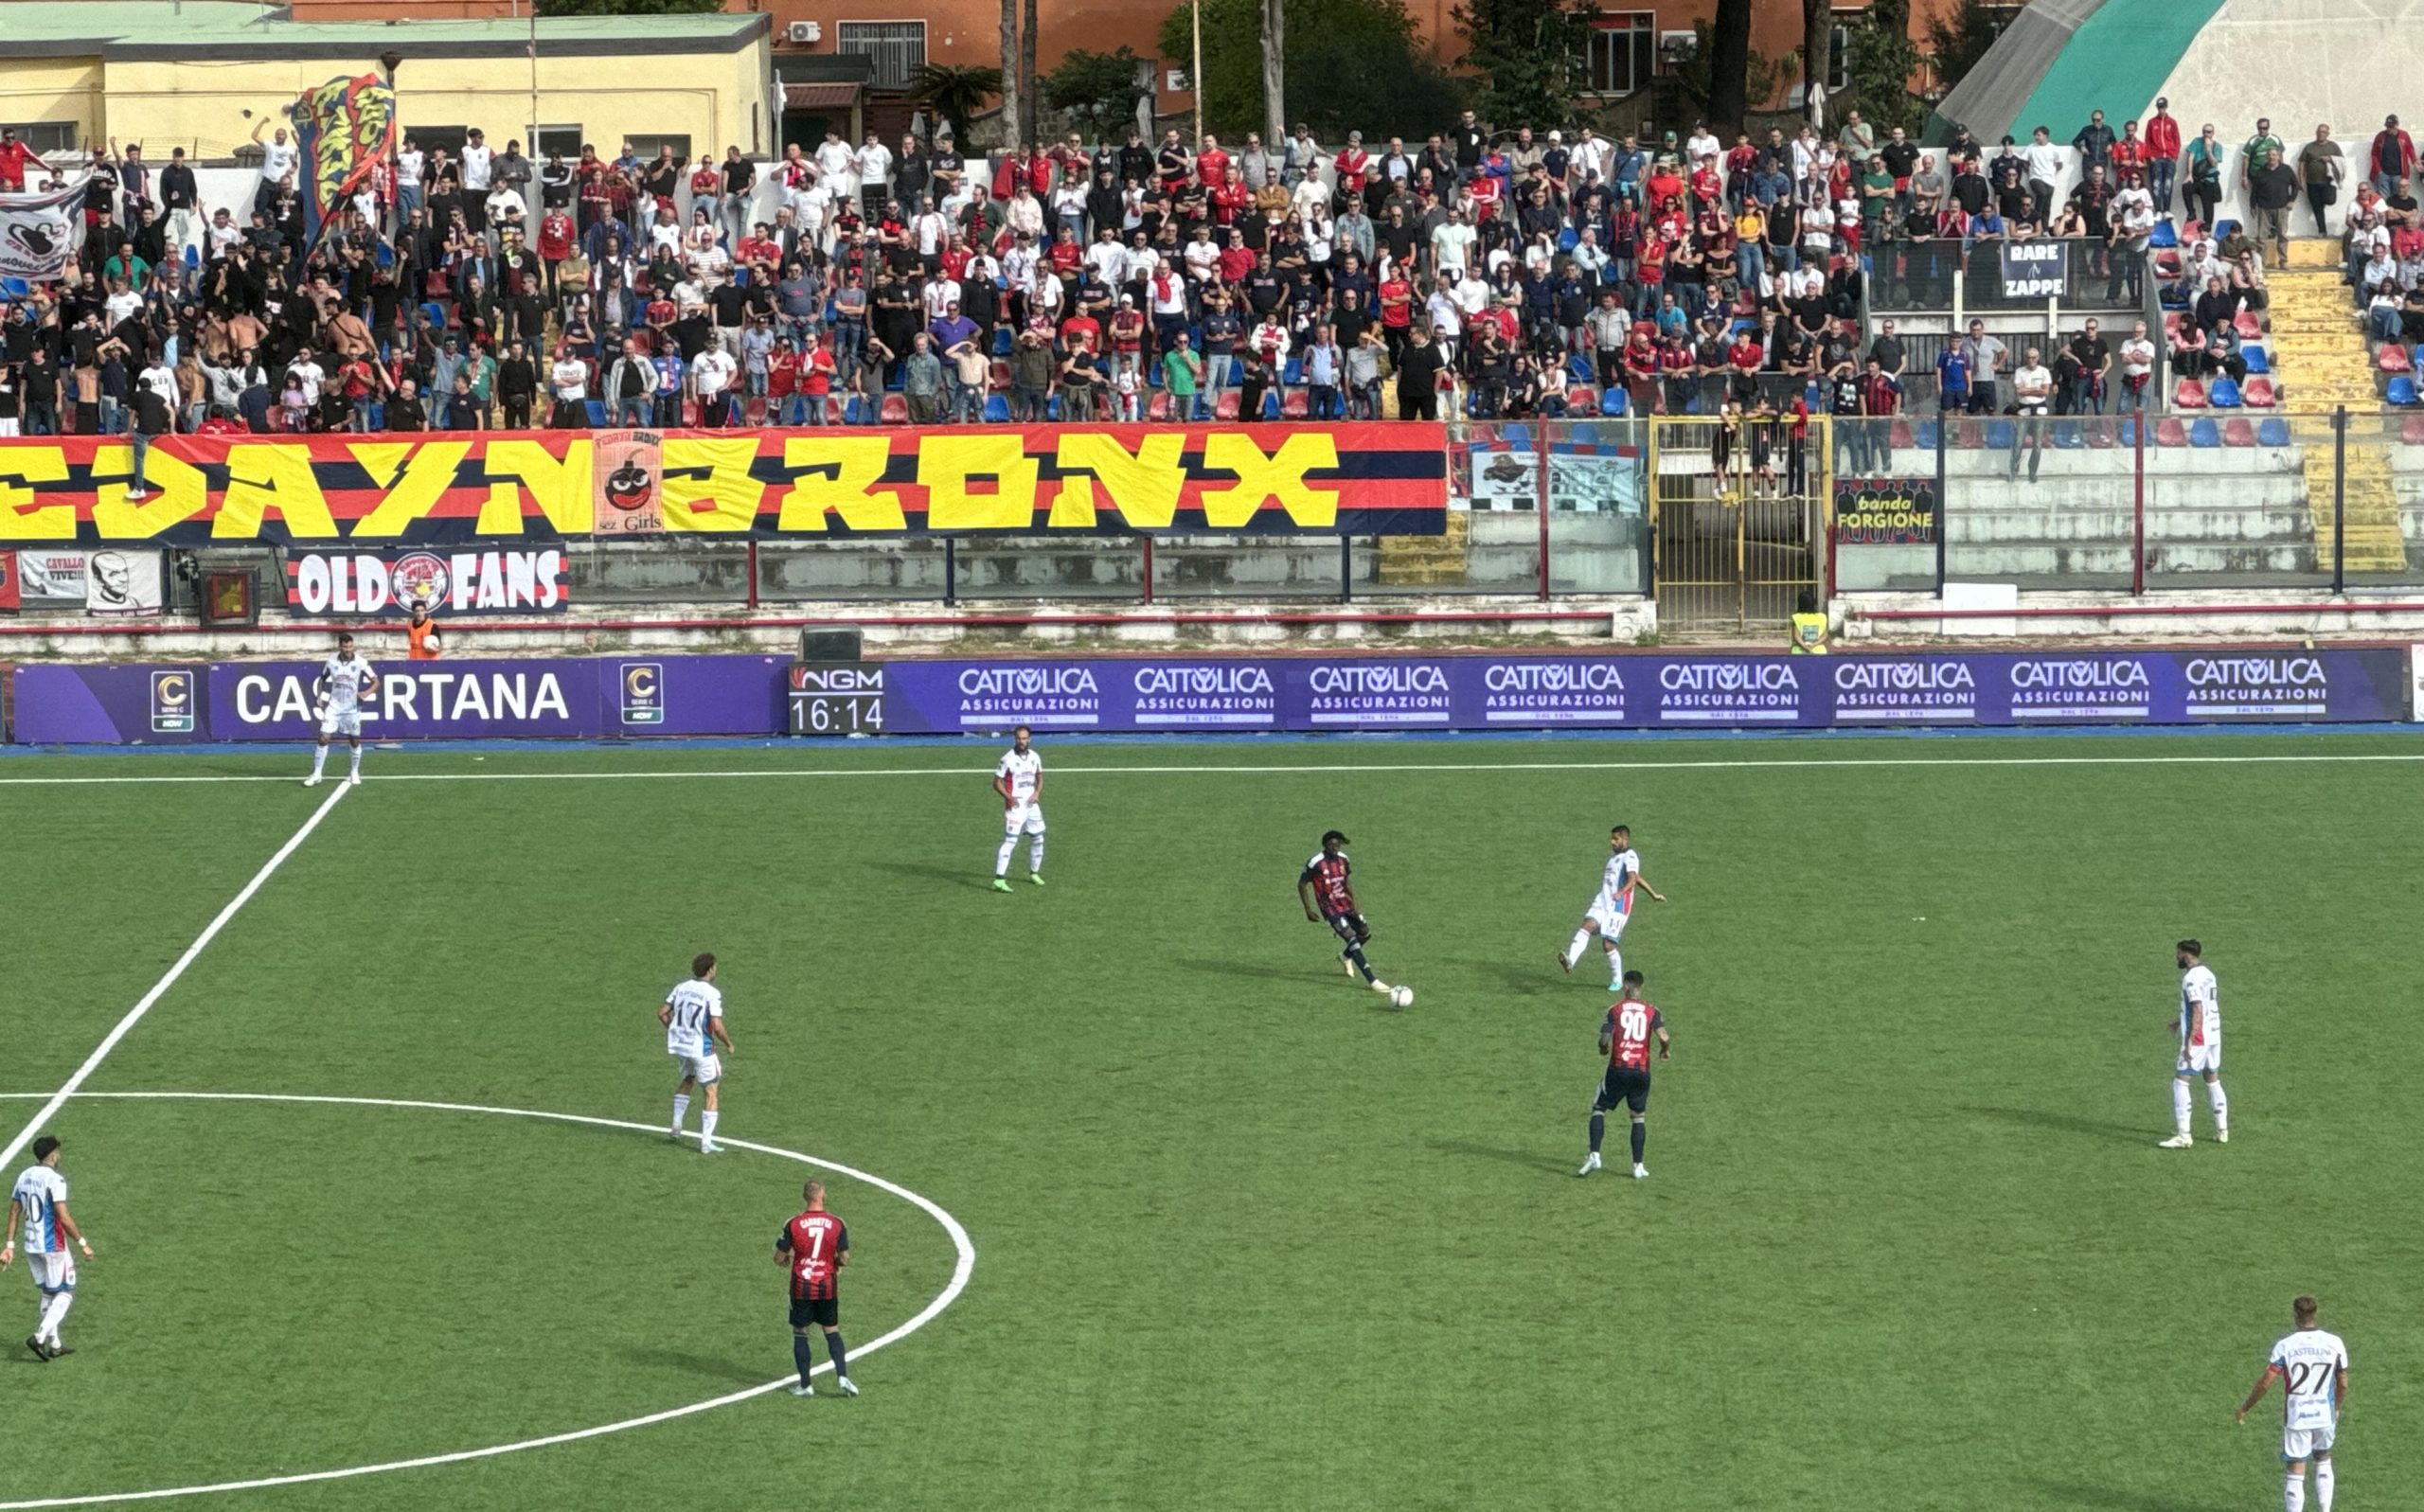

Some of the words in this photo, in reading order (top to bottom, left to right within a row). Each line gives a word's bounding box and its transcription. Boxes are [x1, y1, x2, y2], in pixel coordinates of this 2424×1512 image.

[2005, 278, 2063, 296] ZAPPE
[662, 433, 1340, 532] BRONX
[1858, 495, 1912, 511] banda
[624, 514, 662, 532] Girls
[1838, 512, 1934, 528] FORGIONE
[46, 557, 85, 569] CAVALLO
[297, 553, 390, 614] OLD
[452, 550, 561, 611] FANS
[801, 668, 883, 690] NGM
[958, 668, 1098, 695] CATTOLICA
[1134, 667, 1274, 693] CATTOLICA
[1310, 667, 1449, 693] CATTOLICA
[1485, 665, 1625, 691] CATTOLICA
[1660, 664, 1799, 690] CATTOLICA
[1835, 663, 1975, 689] CATTOLICA
[2010, 660, 2149, 687] CATTOLICA
[2185, 658, 2327, 685] CATTOLICA
[960, 698, 1098, 711] ASSICURAZIONI
[1135, 697, 1274, 709] ASSICURAZIONI
[1310, 696, 1450, 708] ASSICURAZIONI
[1486, 694, 1625, 707] ASSICURAZIONI
[1661, 693, 1799, 706] ASSICURAZIONI
[1836, 692, 1976, 704] ASSICURAZIONI
[2011, 690, 2149, 703] ASSICURAZIONI
[2186, 688, 2326, 701] ASSICURAZIONI
[792, 698, 883, 731] 16:14
[677, 999, 704, 1028] 17
[1620, 1010, 1648, 1041] 90
[808, 1227, 825, 1259] 7
[2288, 1361, 2333, 1396] 27
